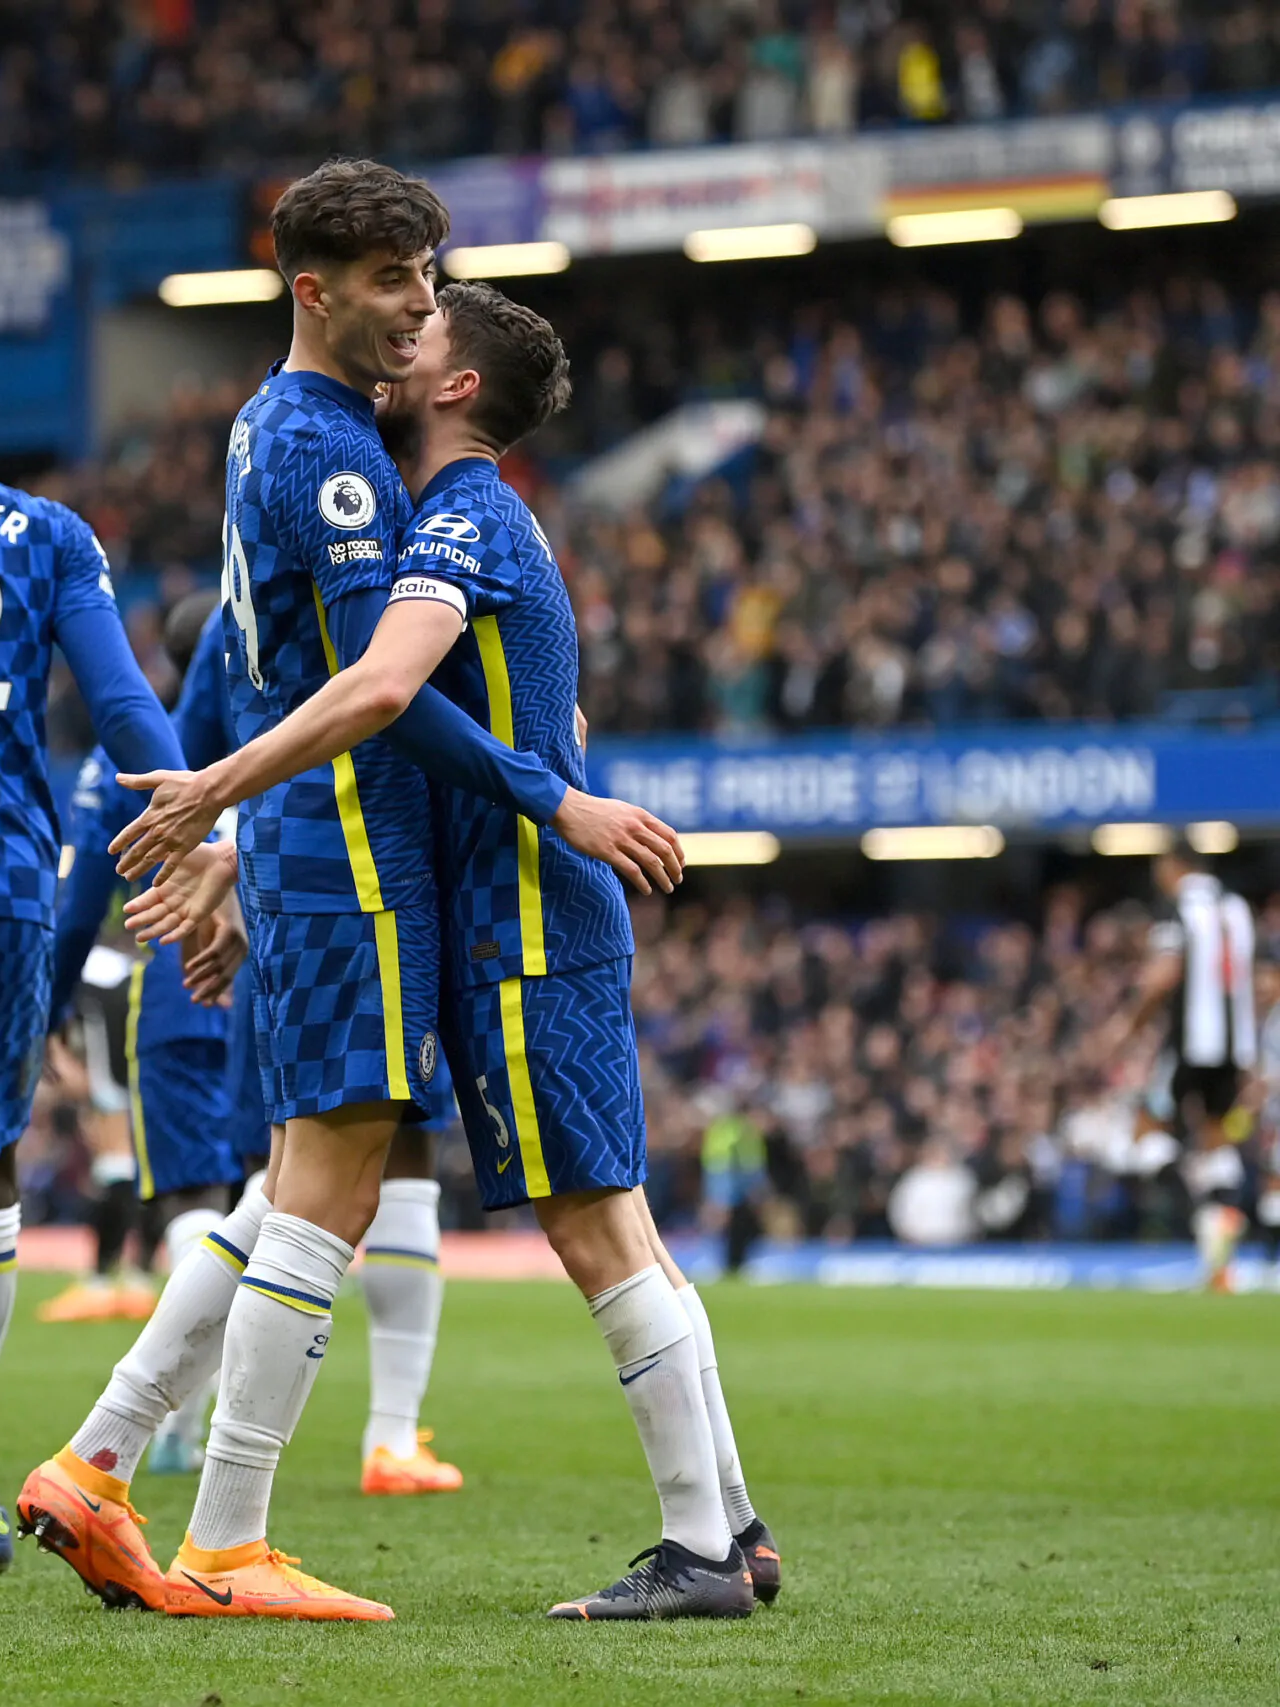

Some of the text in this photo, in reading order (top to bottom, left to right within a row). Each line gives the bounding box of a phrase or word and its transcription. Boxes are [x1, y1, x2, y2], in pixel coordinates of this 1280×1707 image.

[327, 540, 378, 554] No room
[330, 550, 383, 566] for racism
[398, 541, 482, 574] HYUNDAI
[609, 759, 701, 826] THE
[713, 753, 859, 824] PRIDE
[929, 743, 1156, 817] LONDON
[476, 1074, 509, 1148] 5
